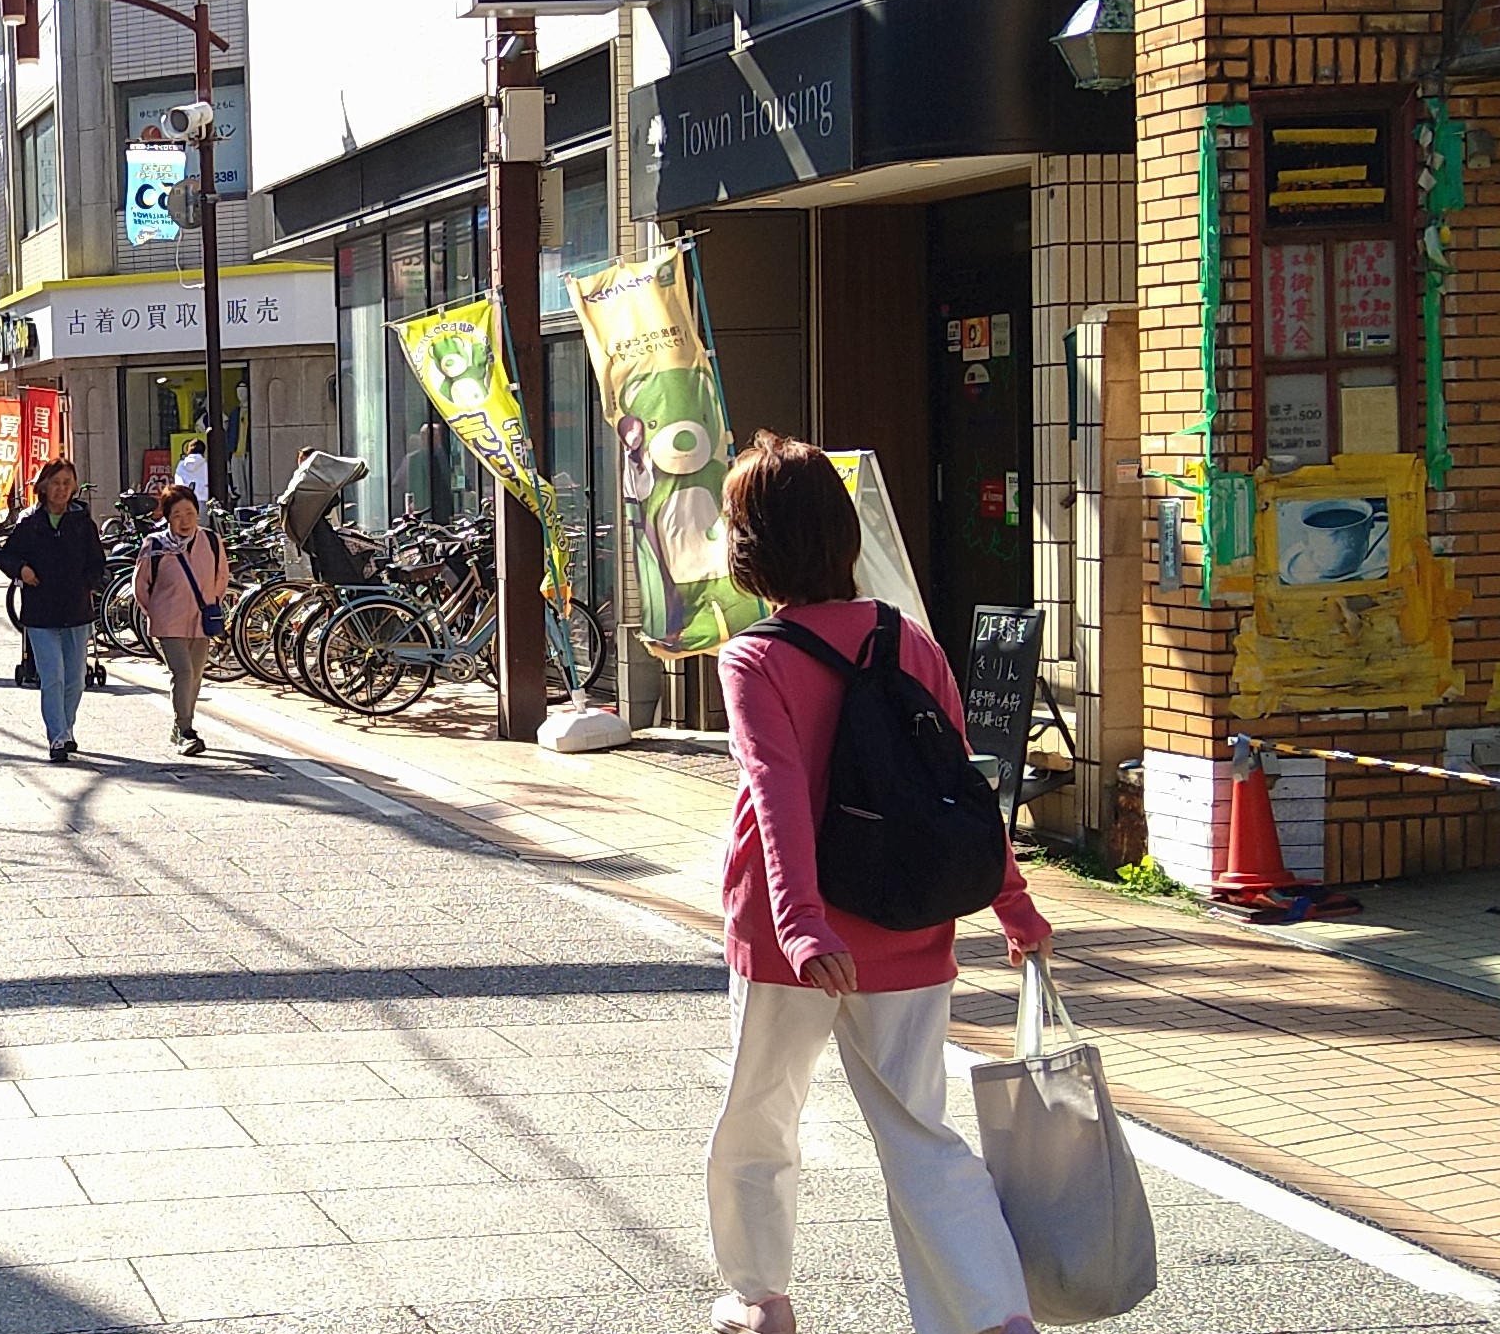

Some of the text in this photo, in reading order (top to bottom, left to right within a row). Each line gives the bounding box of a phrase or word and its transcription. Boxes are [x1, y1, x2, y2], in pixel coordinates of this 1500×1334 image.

[678, 73, 833, 158] Town Housing
[66, 296, 280, 337] 古着の買取販売
[975, 654, 1020, 681] きりん
